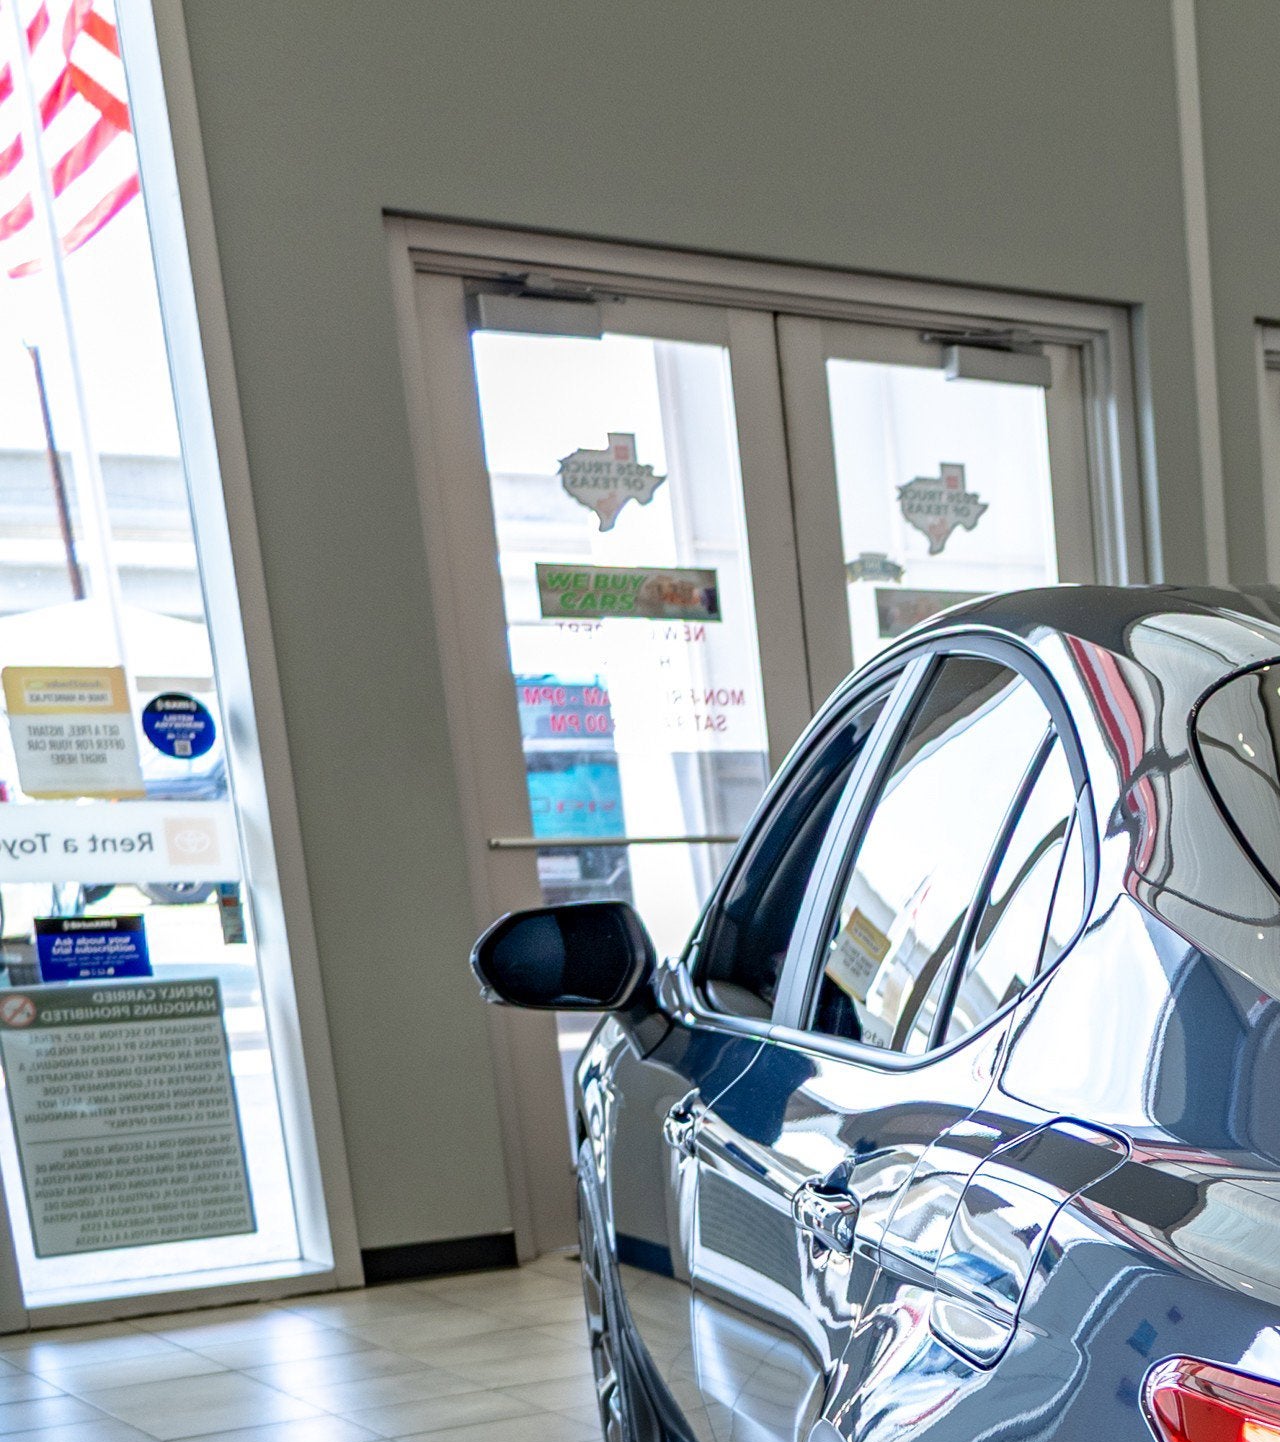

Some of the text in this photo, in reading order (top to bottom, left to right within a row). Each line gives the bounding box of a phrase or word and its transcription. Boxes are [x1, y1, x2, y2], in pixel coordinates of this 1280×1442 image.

[546, 572, 646, 590] WE BUY
[559, 591, 638, 611] CARS
